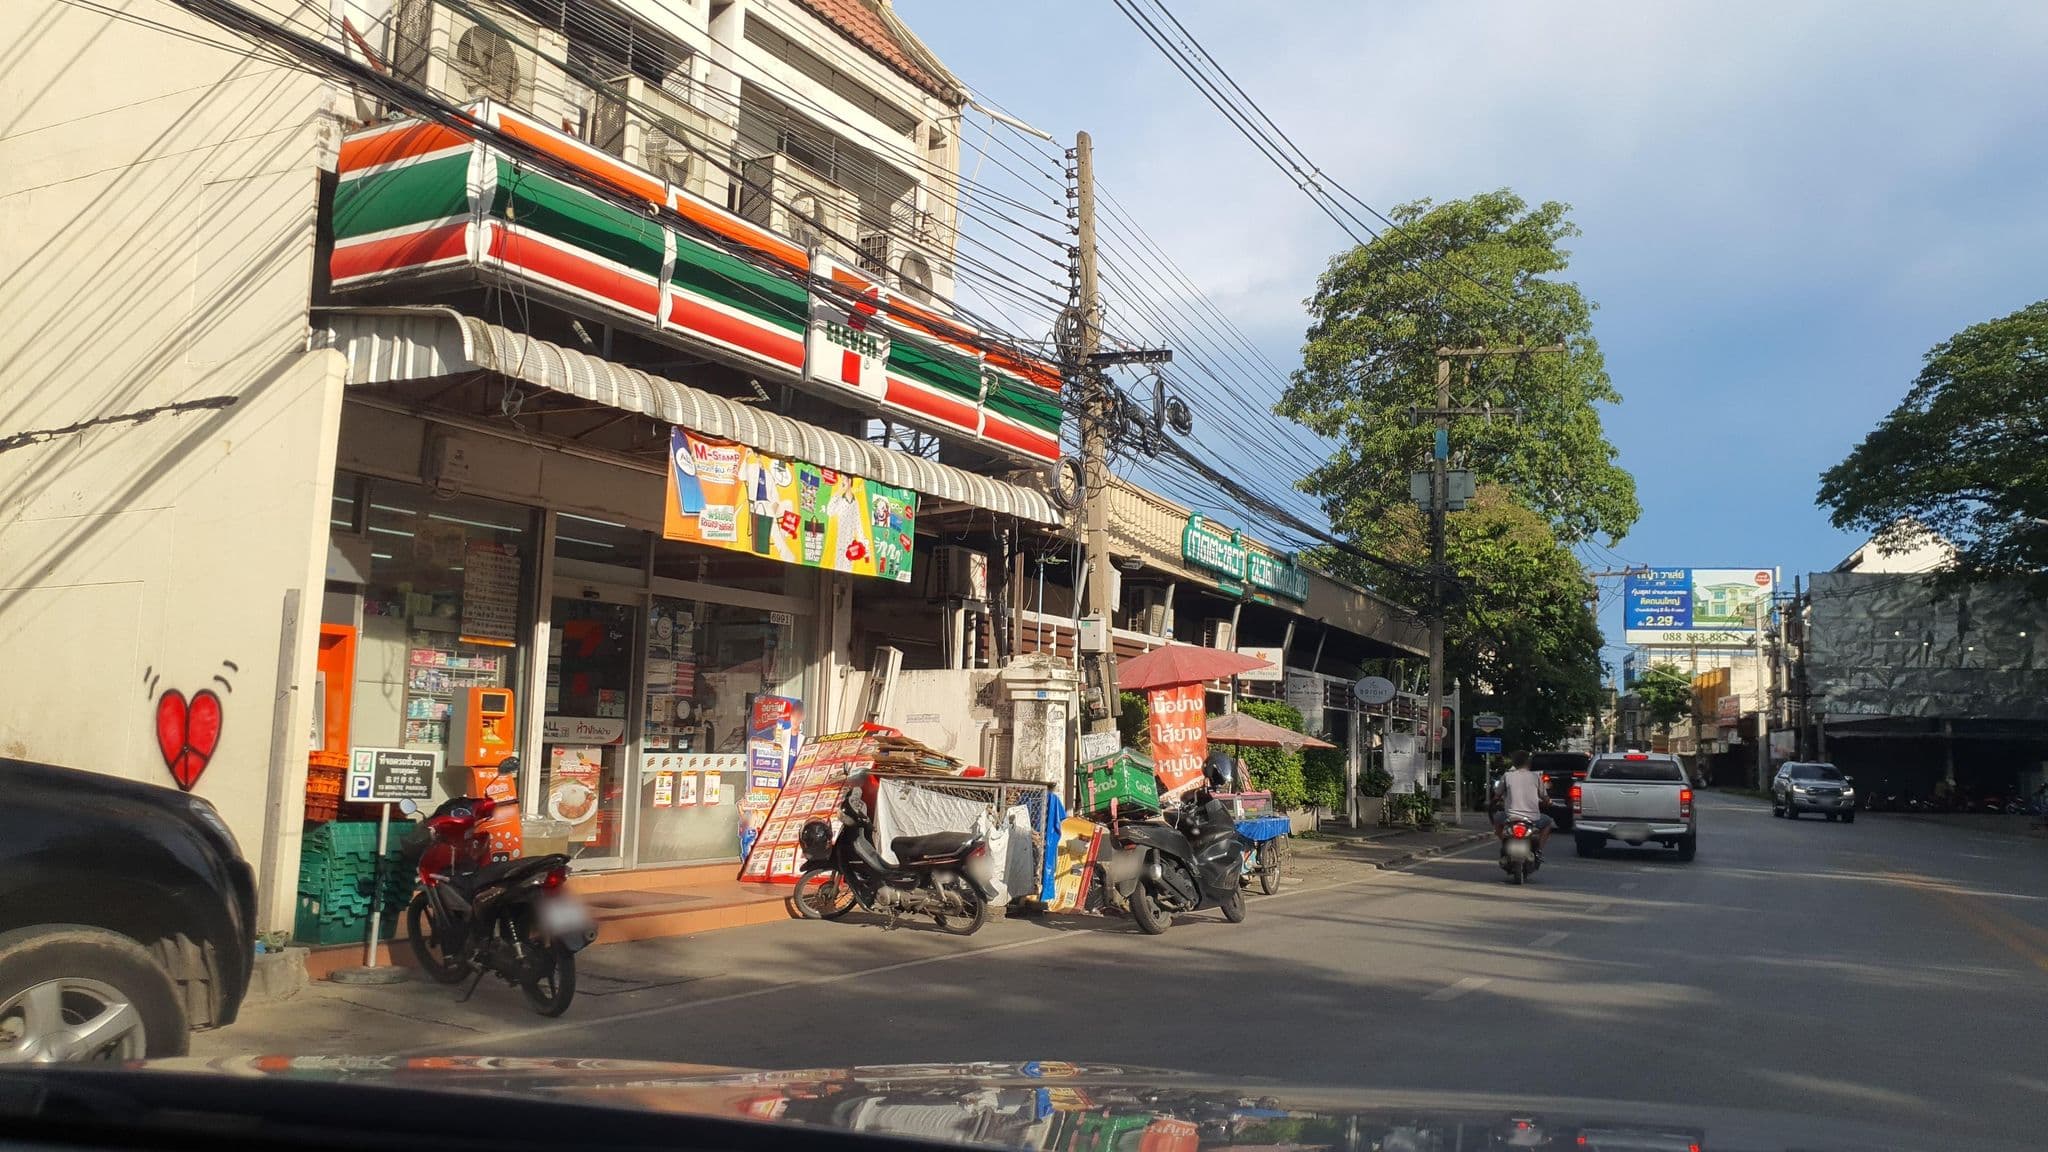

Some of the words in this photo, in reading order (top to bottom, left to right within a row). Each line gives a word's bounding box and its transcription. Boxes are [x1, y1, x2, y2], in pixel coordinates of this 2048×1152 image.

[1645, 615, 1673, 626] 2.29
[1662, 632, 1682, 642] 088
[1154, 722, 1202, 743] ไส้ย่าง
[1158, 748, 1204, 777] หมูปิ้ง
[353, 777, 370, 797] P
[1094, 776, 1118, 793] rab
